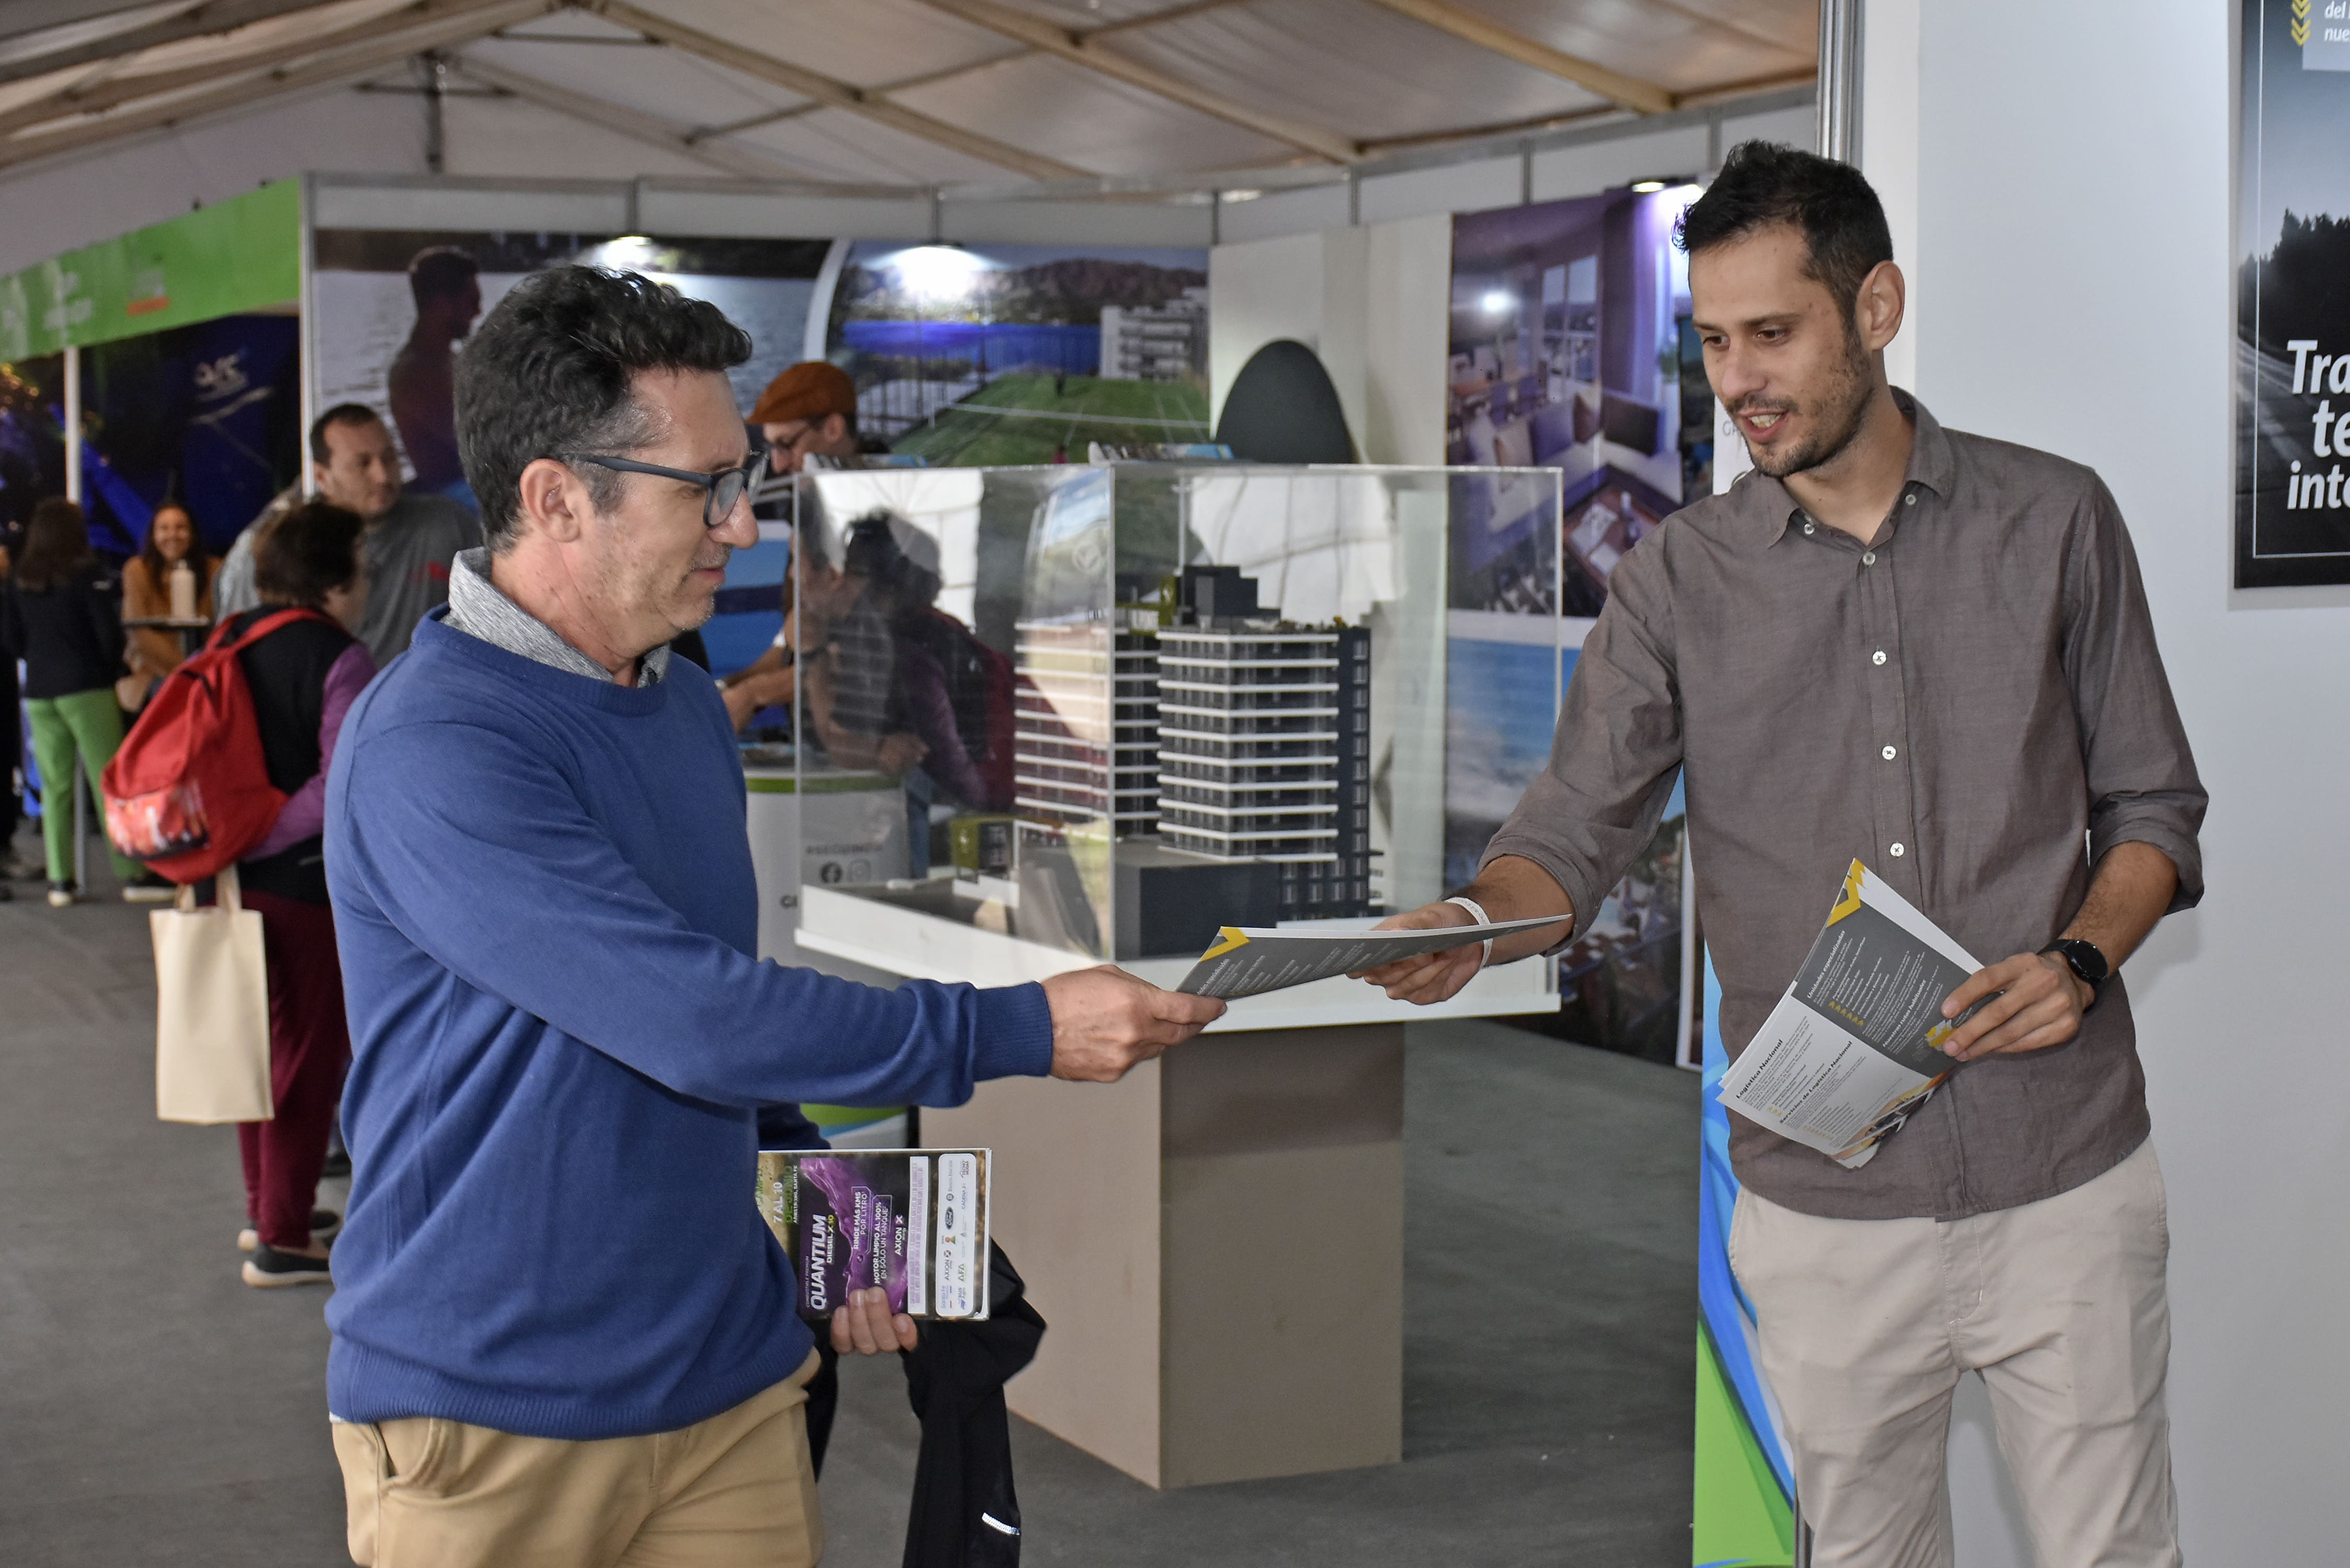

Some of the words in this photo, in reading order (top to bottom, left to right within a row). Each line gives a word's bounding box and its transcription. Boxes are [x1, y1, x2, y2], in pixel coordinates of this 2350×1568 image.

[2324, 1, 2346, 19] del
[2287, 340, 2350, 395] Tra
[1806, 971, 1825, 999] Unidades
[1822, 930, 1846, 972] especializadas
[1882, 1023, 1902, 1048] Nuestras
[1899, 1009, 1911, 1025] rutas
[1908, 979, 1927, 1010] habituales
[1735, 1069, 1761, 1099] Logística
[1759, 1039, 1784, 1070] Nacional
[1779, 1099, 1803, 1124] Servicios
[1802, 1092, 1810, 1100] de
[1808, 1067, 1831, 1093] Logística
[1830, 1041, 1852, 1068] Nacional
[774, 1182, 783, 1194] 10
[774, 1196, 783, 1214] AL
[874, 1222, 881, 1231] AL
[881, 1238, 886, 1248] UN
[811, 1214, 827, 1310] QUANTIUM
[881, 1270, 887, 1278] EN
